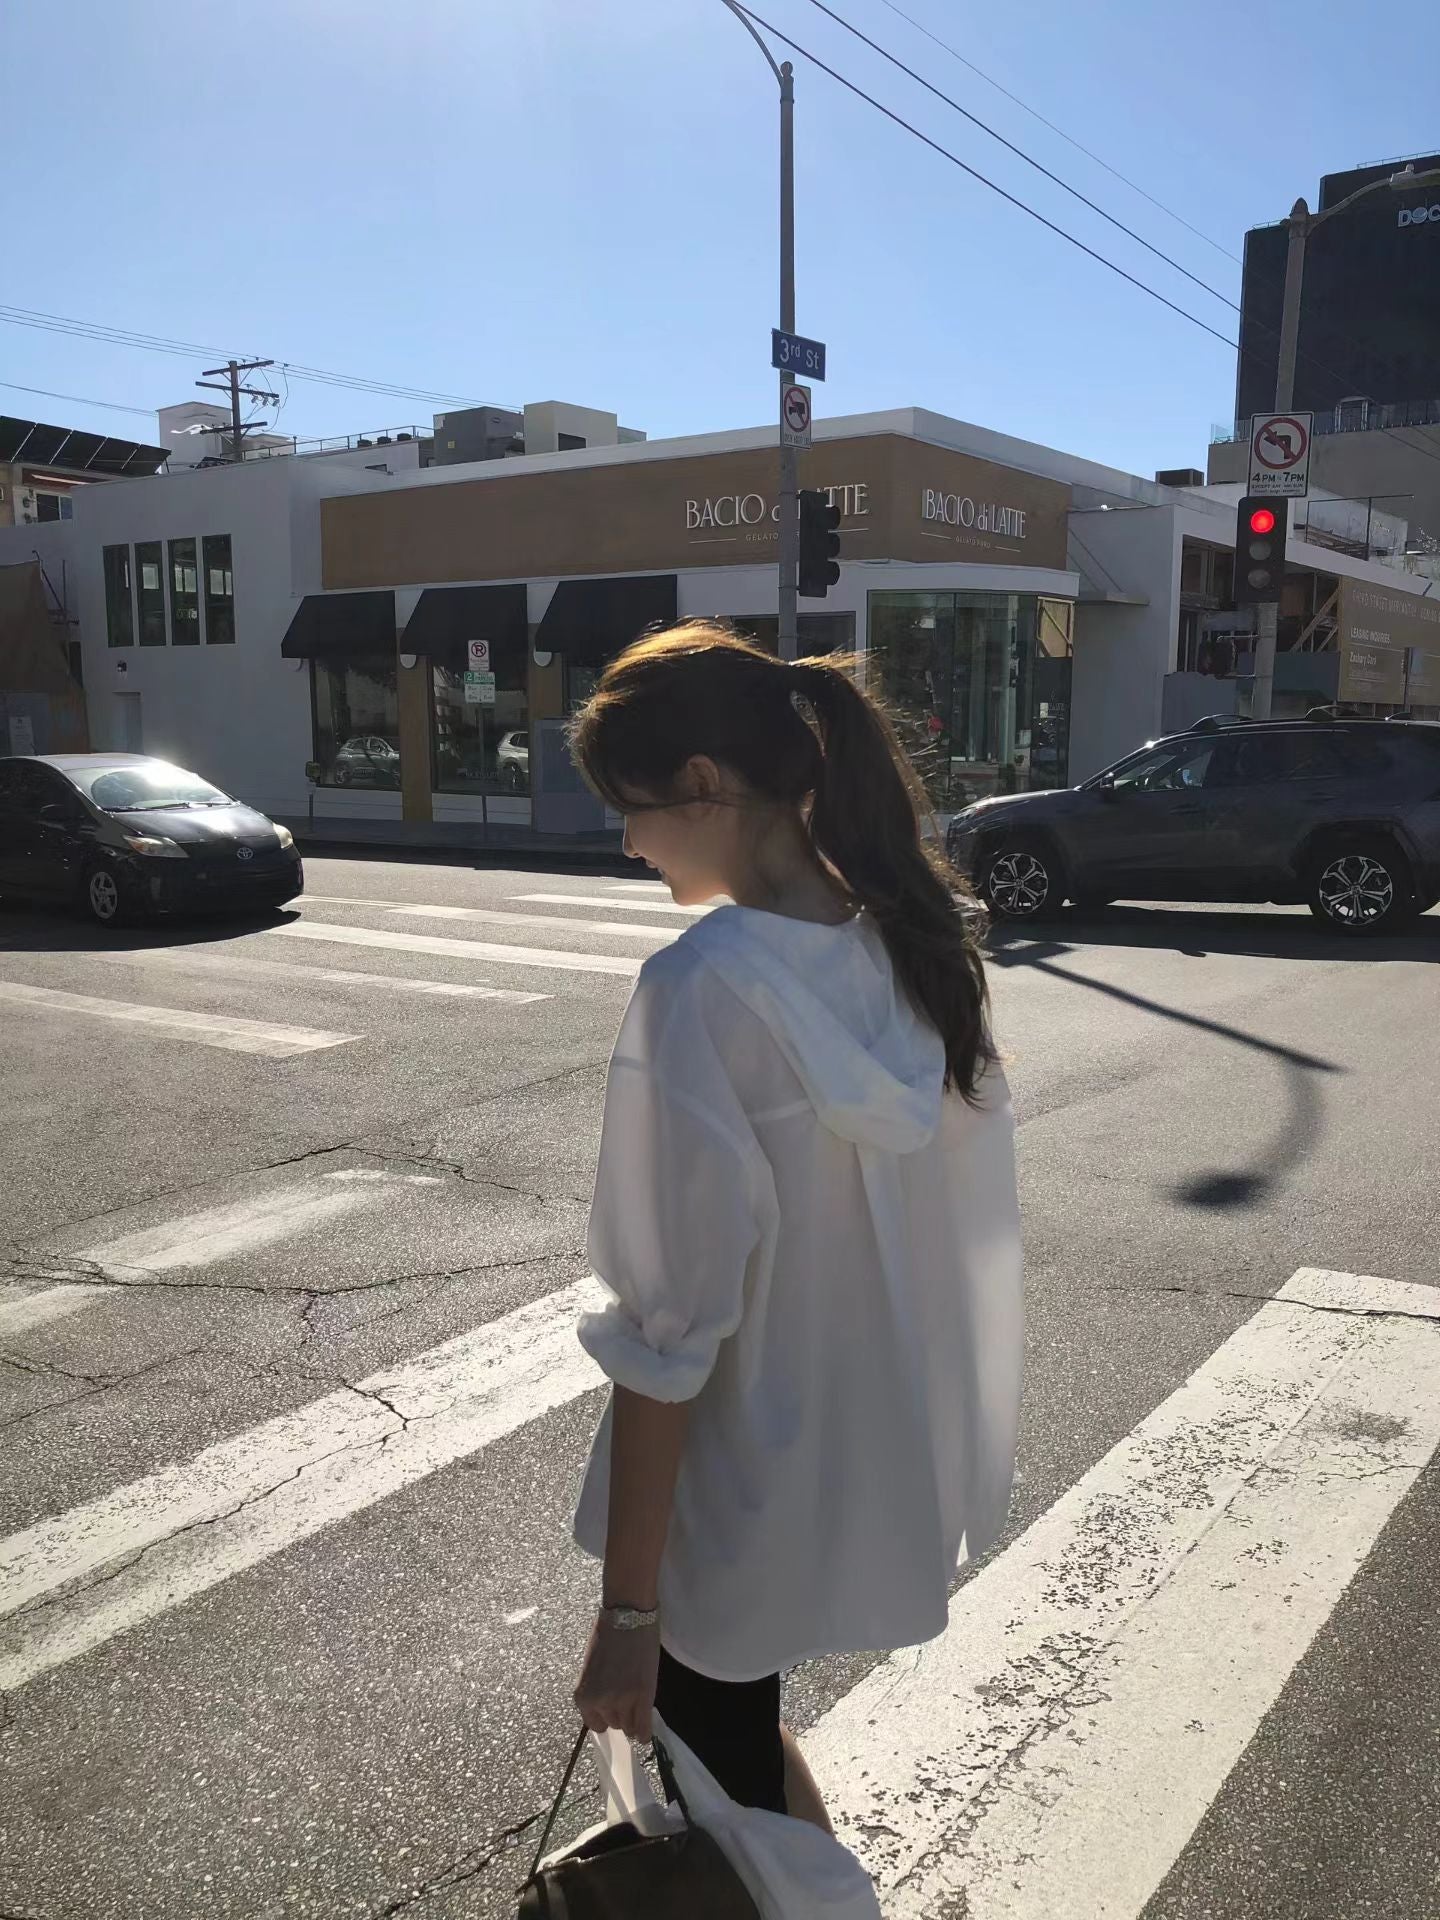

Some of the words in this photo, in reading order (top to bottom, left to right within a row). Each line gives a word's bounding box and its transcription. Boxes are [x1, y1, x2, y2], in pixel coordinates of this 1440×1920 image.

[780, 338, 801, 364] 3rd
[806, 349, 819, 370] St
[685, 494, 765, 529] BACIO
[924, 488, 975, 528] BACIO
[977, 503, 988, 531] di
[992, 504, 1026, 539] LATTE
[745, 532, 779, 542] GELATO
